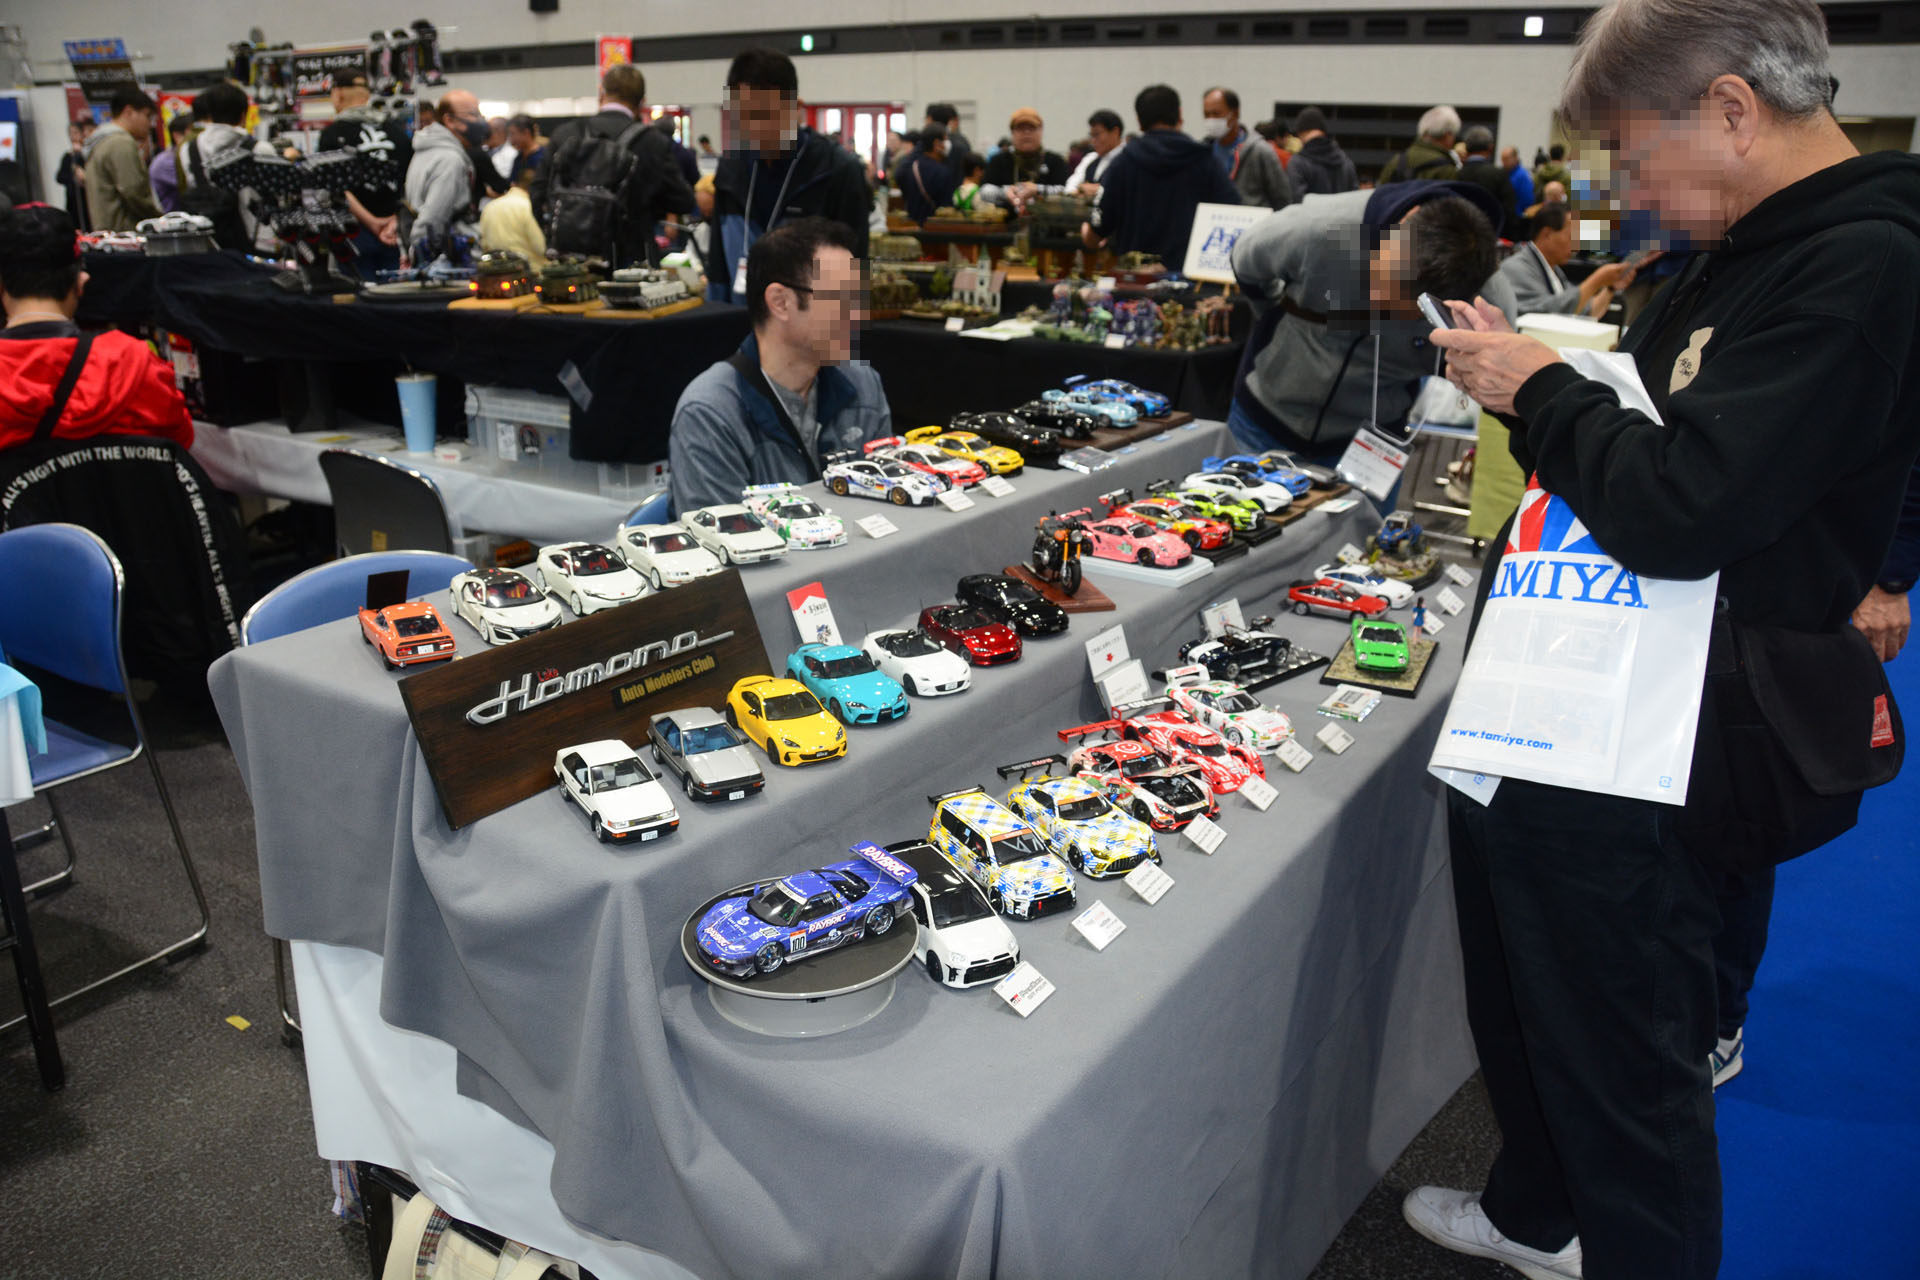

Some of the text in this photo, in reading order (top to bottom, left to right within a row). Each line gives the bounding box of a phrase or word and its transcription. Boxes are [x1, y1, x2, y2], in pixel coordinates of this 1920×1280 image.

[56, 448, 92, 468] WITH
[93, 446, 121, 460] THE
[864, 477, 875, 487] 25
[537, 667, 560, 682] Lake
[620, 654, 716, 704] Auto Modelers Club
[1450, 728, 1553, 751] www.tamiya.com
[859, 845, 912, 878] RAYBRIG
[808, 912, 847, 935] RAYBRIG
[792, 936, 805, 952] 100
